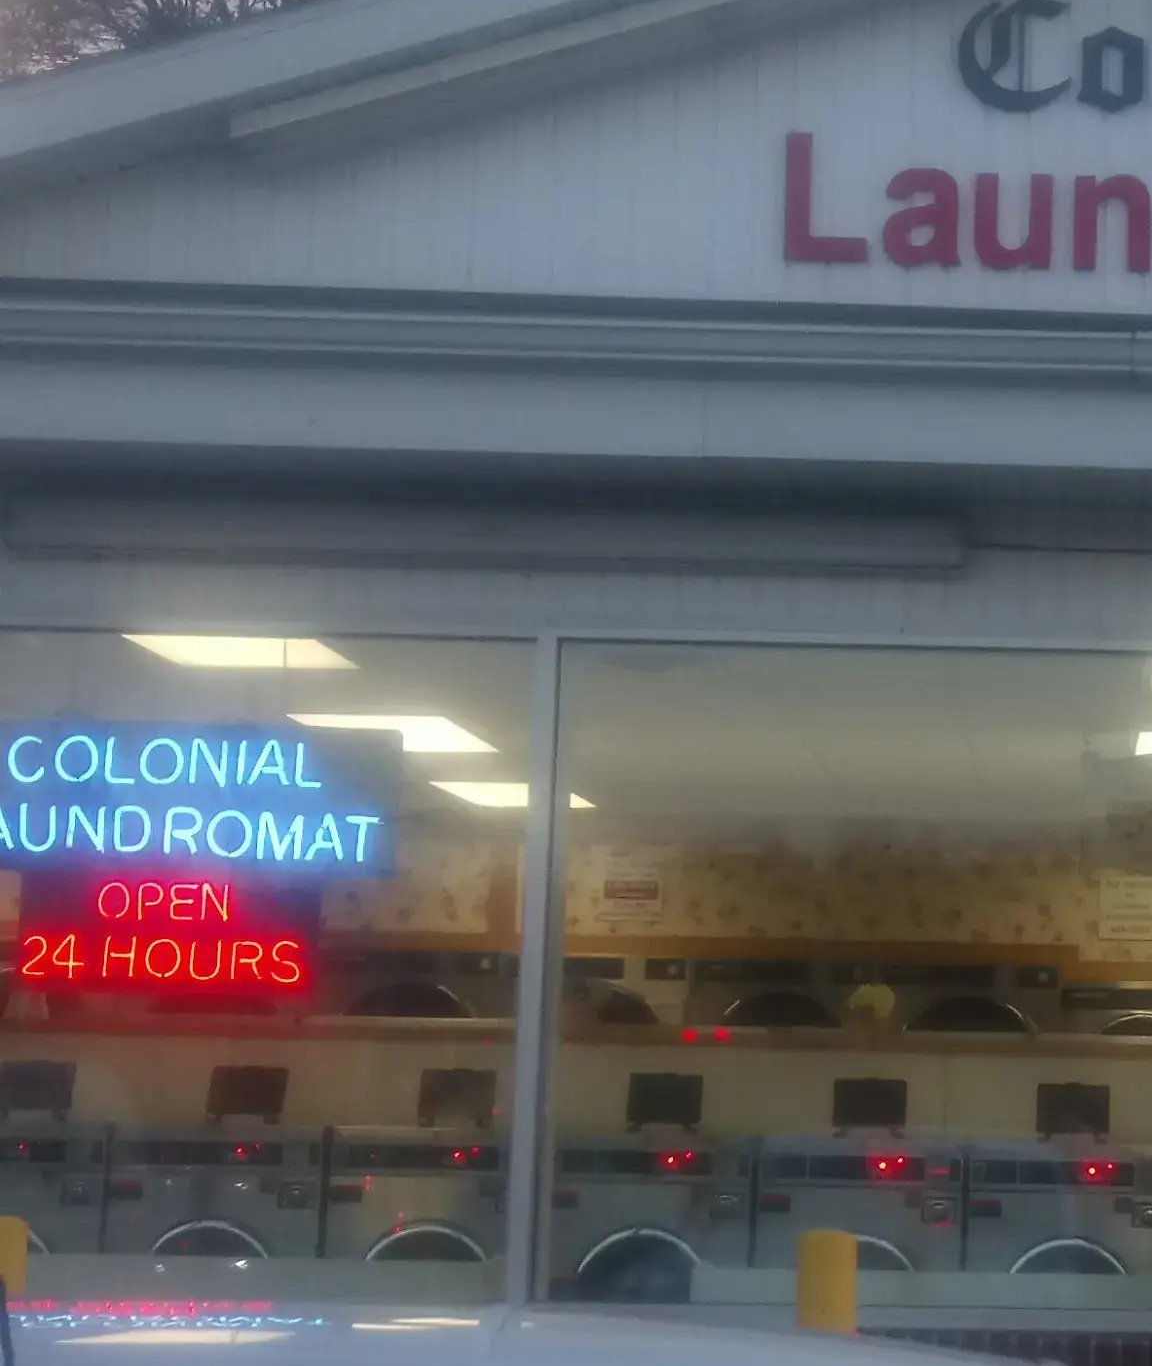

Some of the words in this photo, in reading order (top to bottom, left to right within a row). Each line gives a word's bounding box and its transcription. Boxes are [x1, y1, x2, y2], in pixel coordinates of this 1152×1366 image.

[7, 735, 322, 788] COLONIAL
[98, 882, 230, 922] OPEN
[22, 933, 85, 979] 24
[102, 936, 300, 983] HOURS
